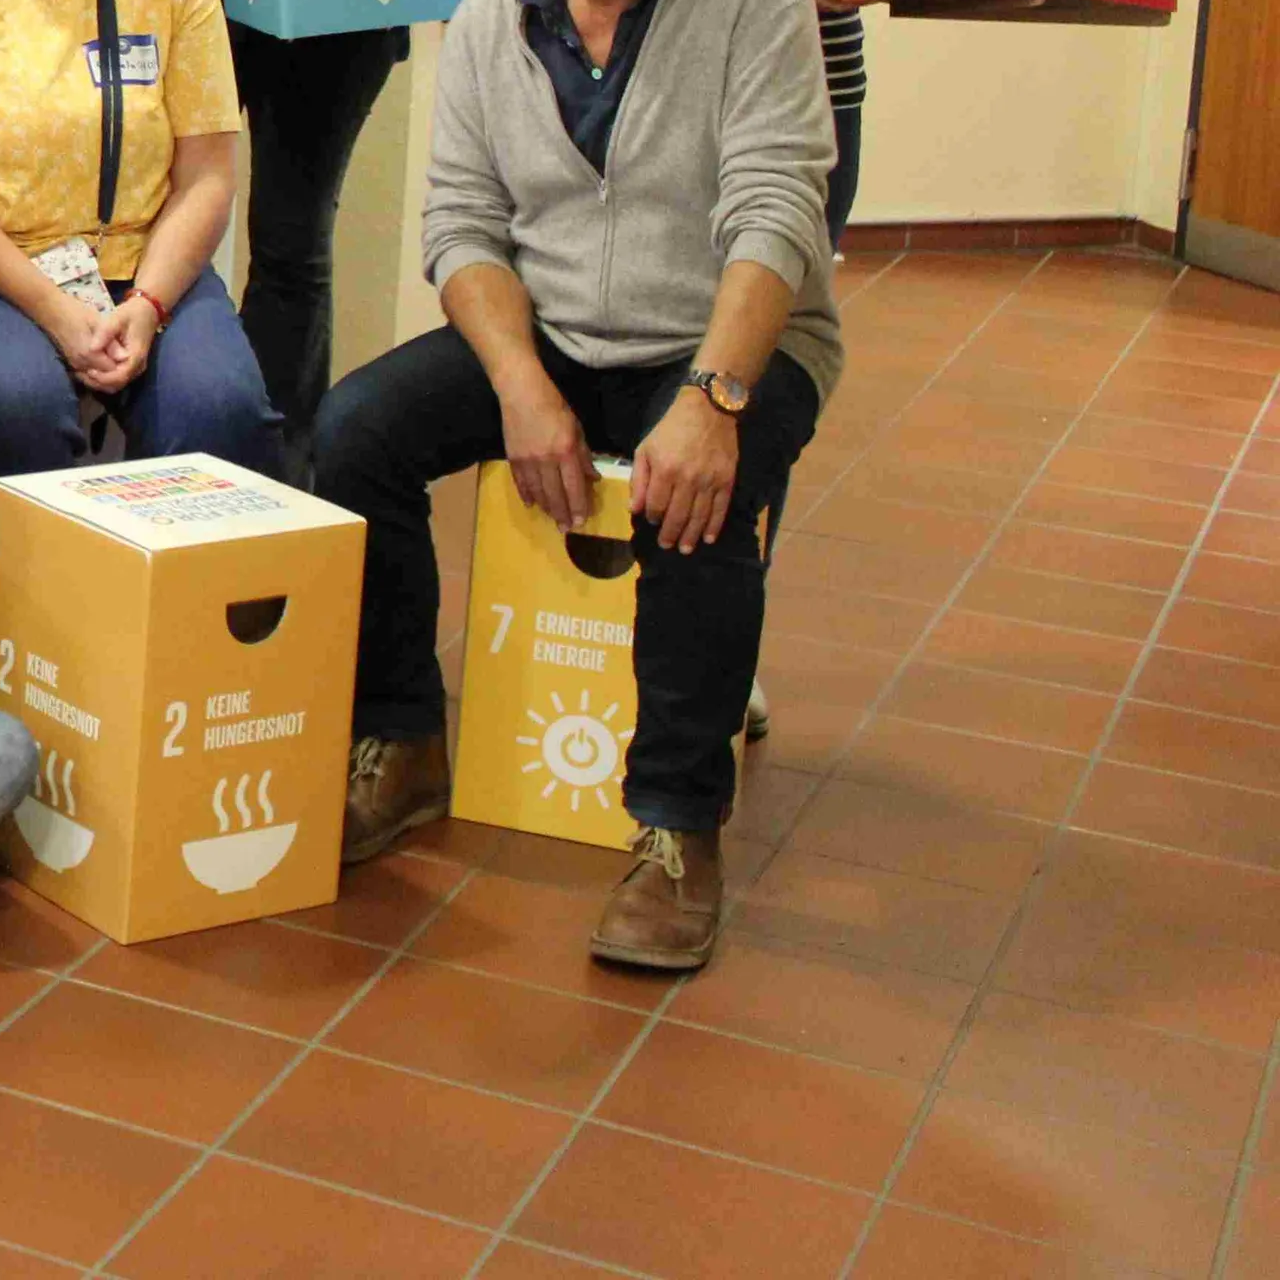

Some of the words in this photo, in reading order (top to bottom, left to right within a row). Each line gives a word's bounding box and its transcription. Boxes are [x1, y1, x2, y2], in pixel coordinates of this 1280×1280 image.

[489, 604, 514, 654] 7
[25, 651, 59, 688] KEINE
[533, 641, 606, 673] ENERGIE
[24, 681, 102, 742] HUNGERSNOT
[162, 700, 188, 758] 2
[206, 689, 251, 720] KEINE
[203, 711, 306, 752] HUNGERSNOT
